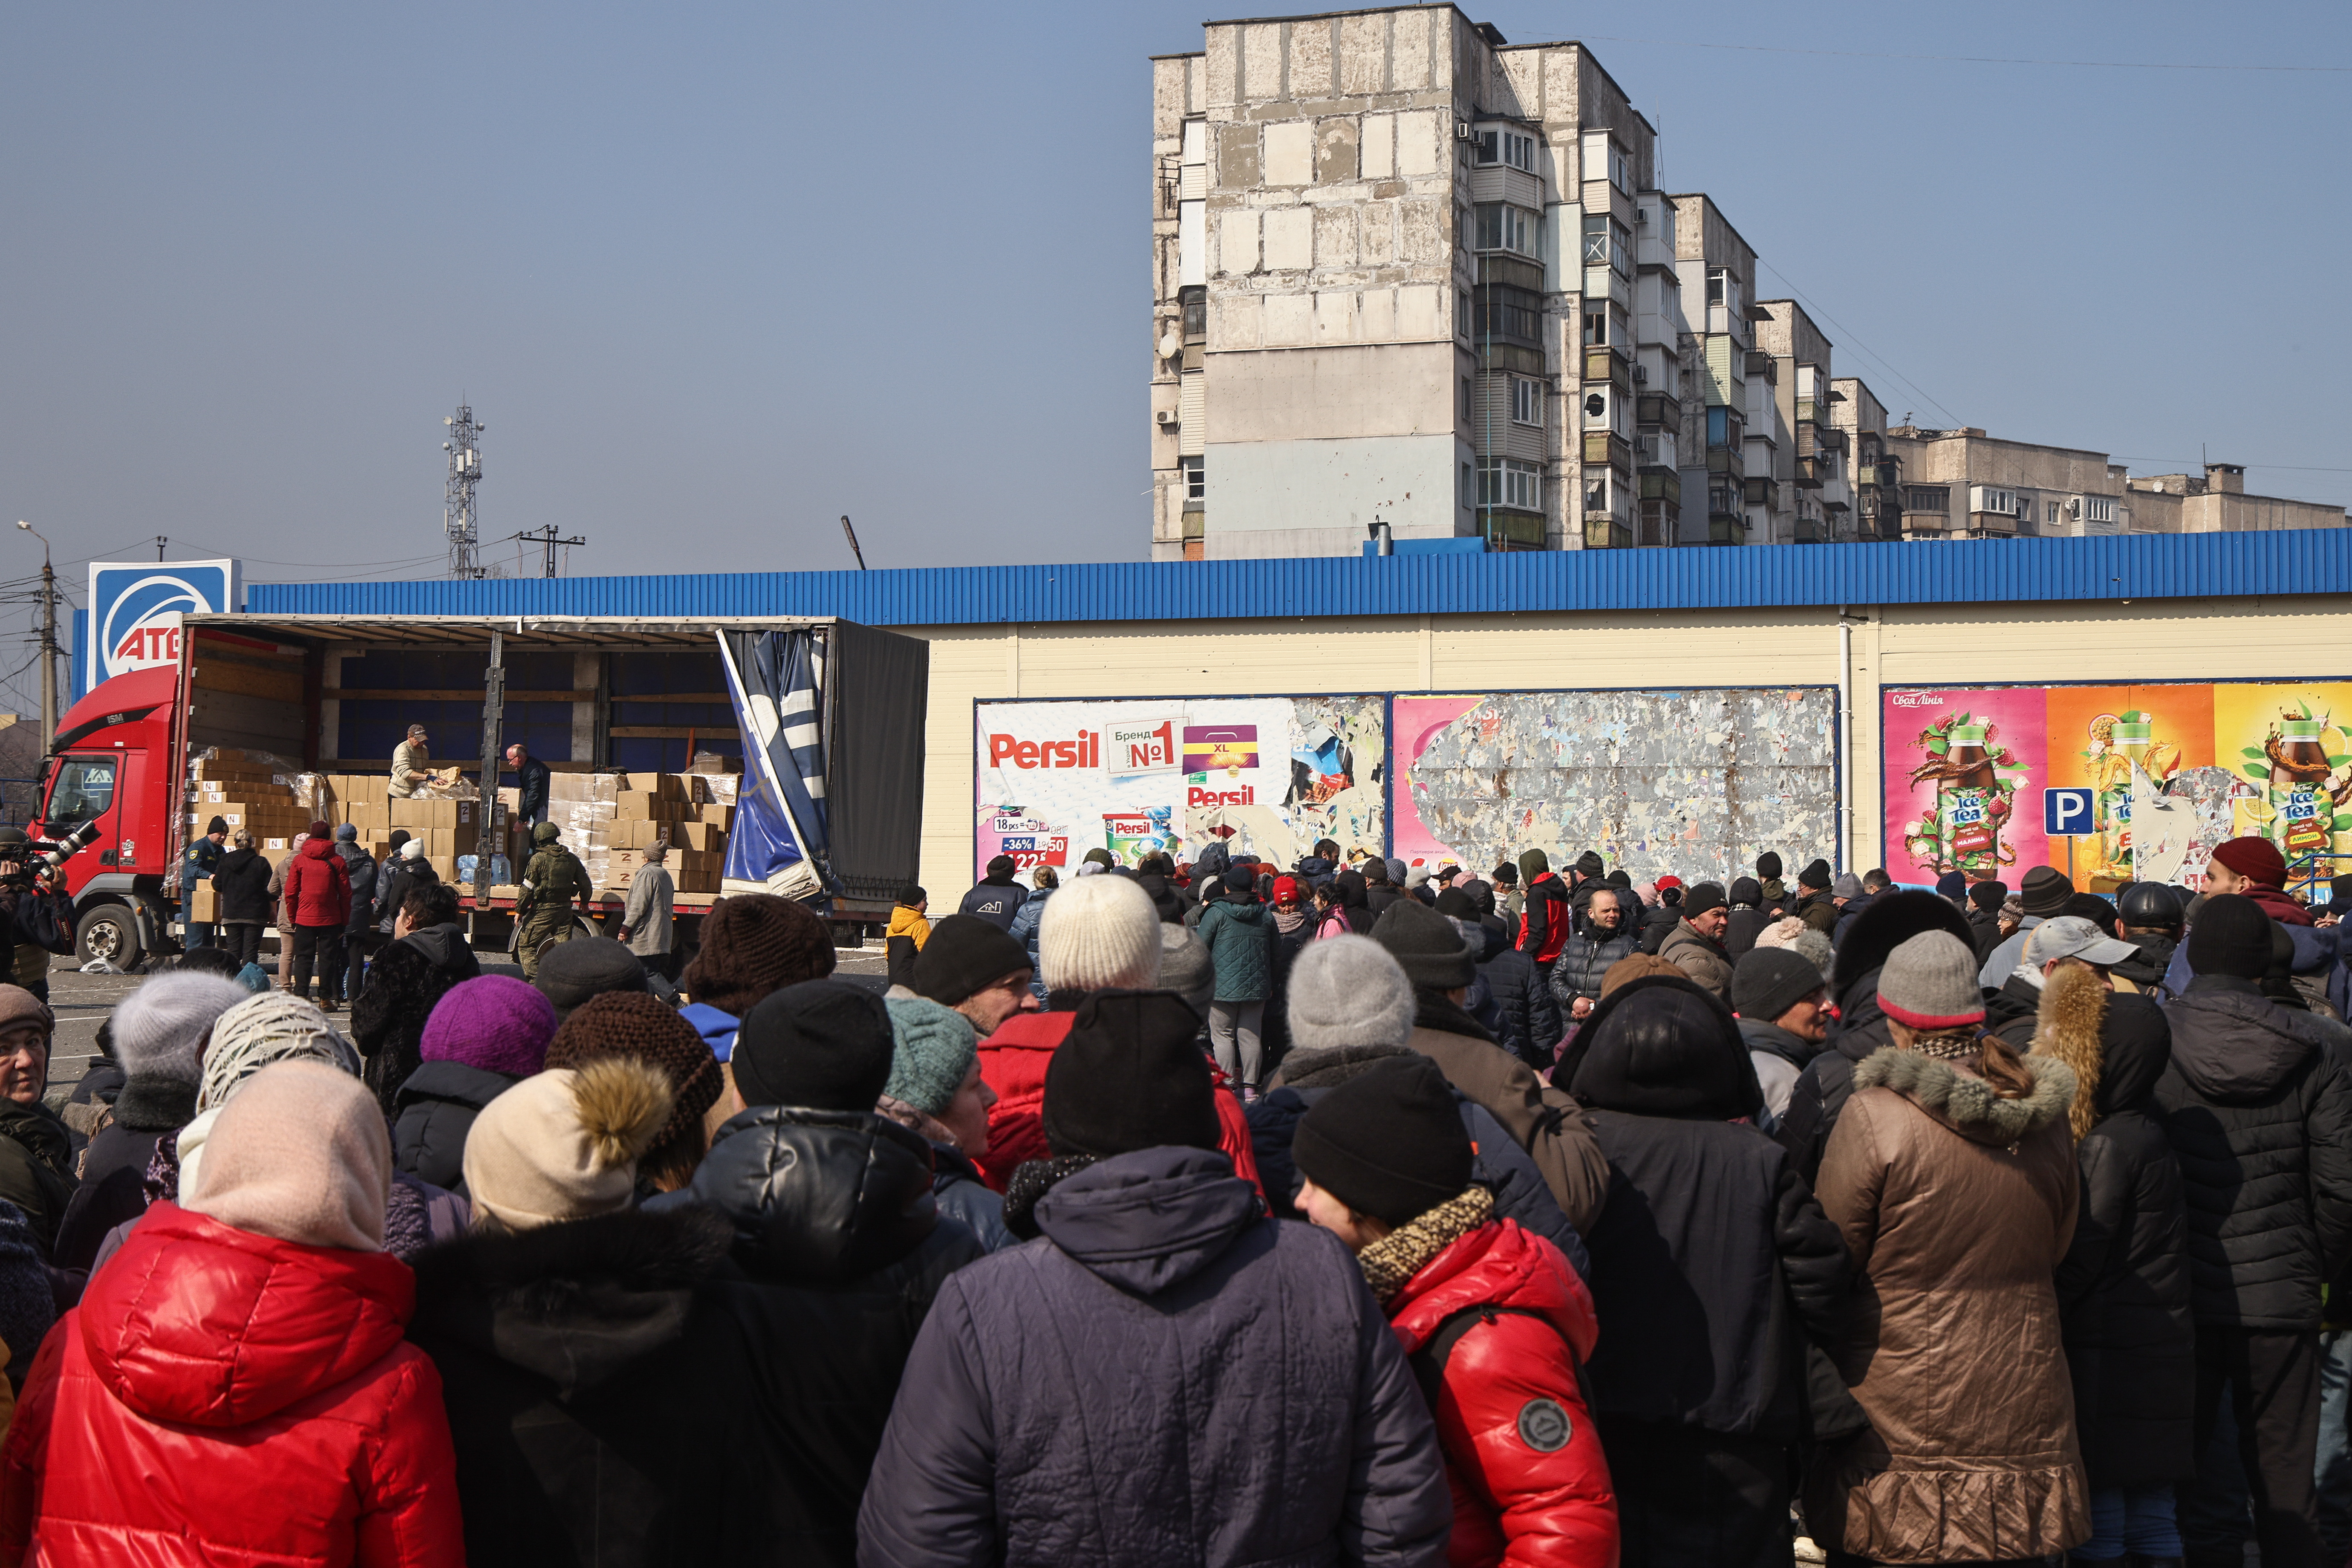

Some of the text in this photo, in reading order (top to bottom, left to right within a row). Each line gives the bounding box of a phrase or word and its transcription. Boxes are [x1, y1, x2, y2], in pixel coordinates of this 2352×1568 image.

[1893, 694, 1944, 705] Своя Лінія
[1115, 731, 1151, 742] Бренд
[990, 729, 1099, 768] Persil
[1214, 744, 1229, 753] XL
[1188, 784, 1254, 806] Persil
[2290, 793, 2313, 804] Ice
[1957, 797, 1980, 808] Ice
[1948, 808, 1980, 823] Tea
[2057, 792, 2084, 830] P
[2113, 804, 2131, 819] Te
[2280, 804, 2315, 819] Tea
[996, 819, 1007, 829] 18
[1009, 822, 1019, 831] pcs
[1116, 821, 1150, 834] Persil
[1957, 836, 1985, 846] МАЛИНА
[2292, 834, 2317, 842] ЛИМОН
[1004, 839, 1032, 849] -36%
